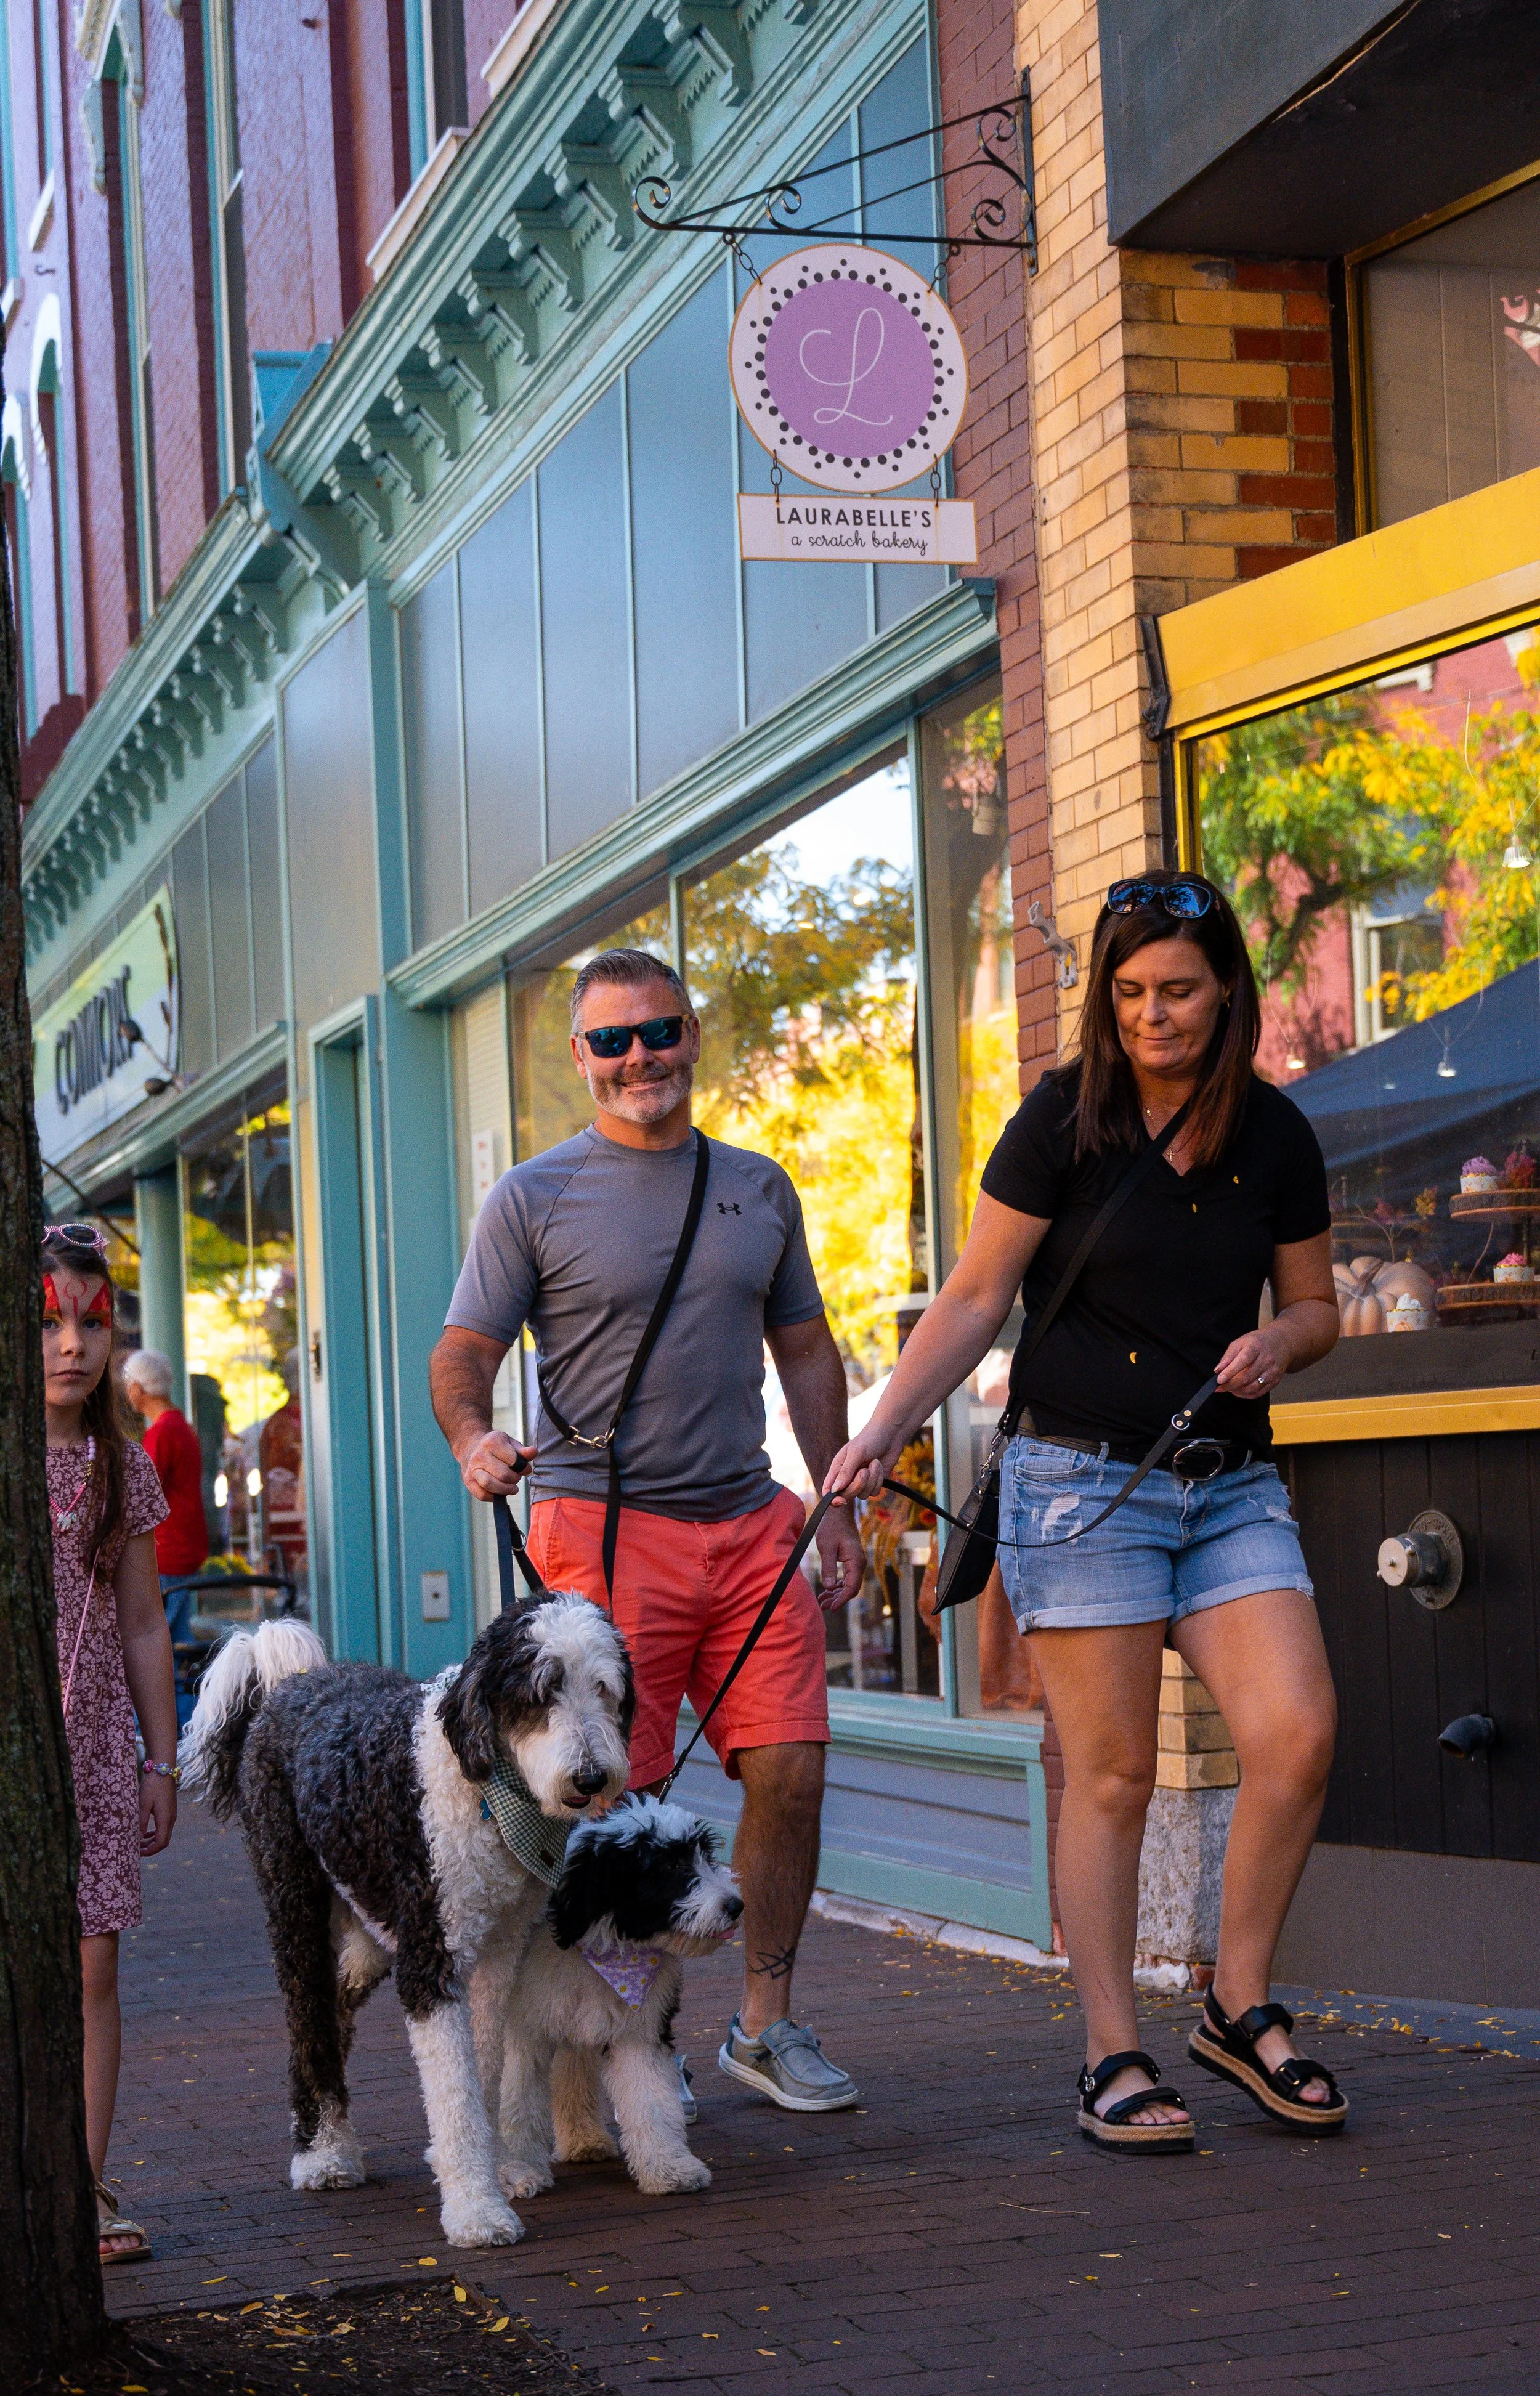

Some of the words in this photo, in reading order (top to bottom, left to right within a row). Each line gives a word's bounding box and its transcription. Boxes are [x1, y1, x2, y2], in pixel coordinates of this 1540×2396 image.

[776, 507, 931, 528] LAURABELLE'S
[791, 535, 802, 546] a
[808, 530, 866, 548] scratch
[872, 530, 928, 556] bakery
